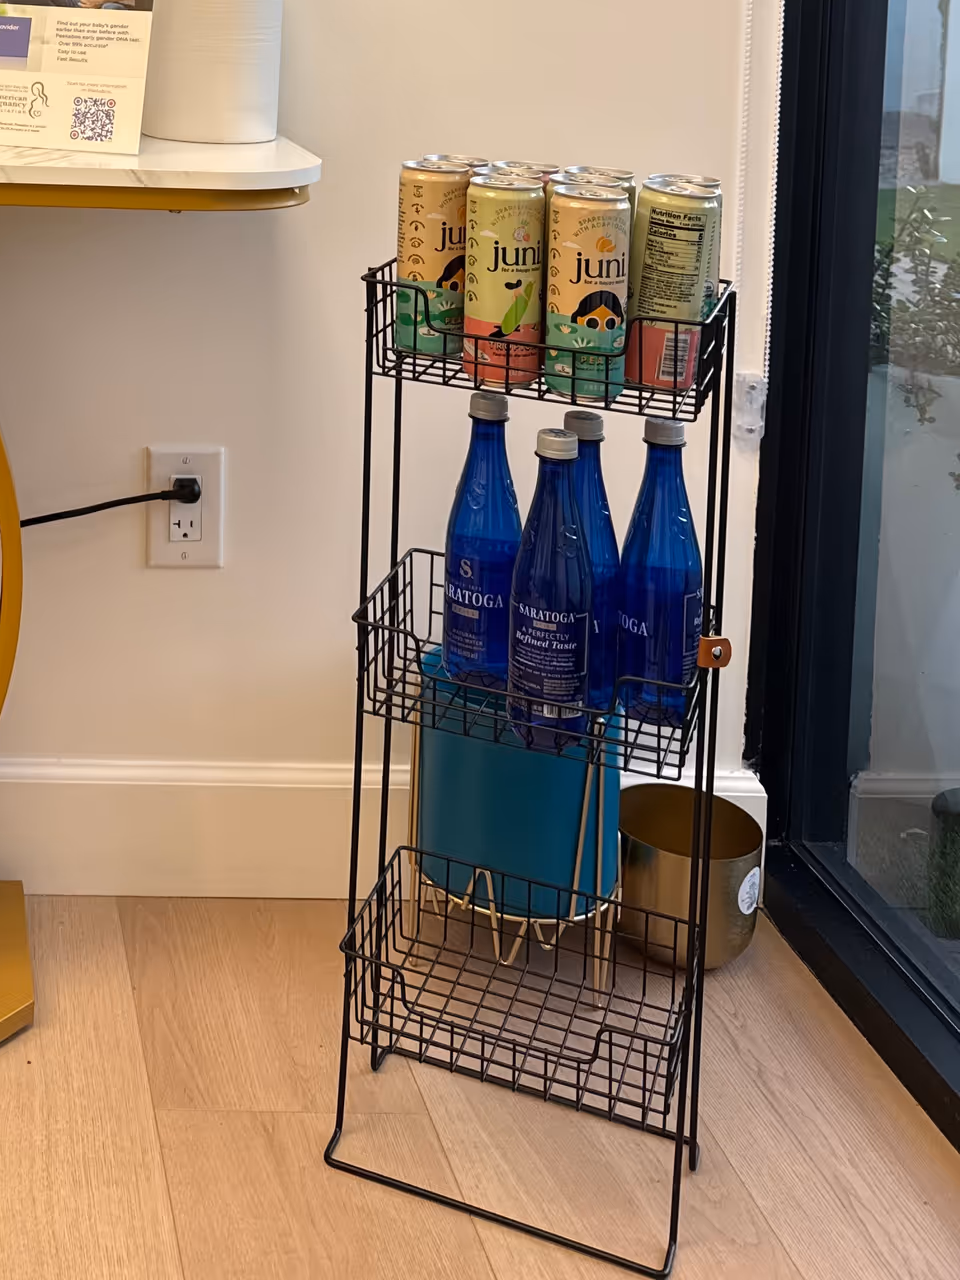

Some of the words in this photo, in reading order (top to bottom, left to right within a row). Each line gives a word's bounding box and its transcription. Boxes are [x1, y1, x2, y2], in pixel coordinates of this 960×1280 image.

[651, 208, 682, 221] Nutrition
[683, 214, 702, 222] Facts
[649, 227, 677, 239] Calories
[486, 240, 542, 273] juni
[568, 251, 627, 285] juni
[518, 602, 576, 624] SARATOGA
[516, 630, 549, 649] Refined
[551, 640, 578, 650] Taste
[528, 628, 570, 641] PERFECTLY
